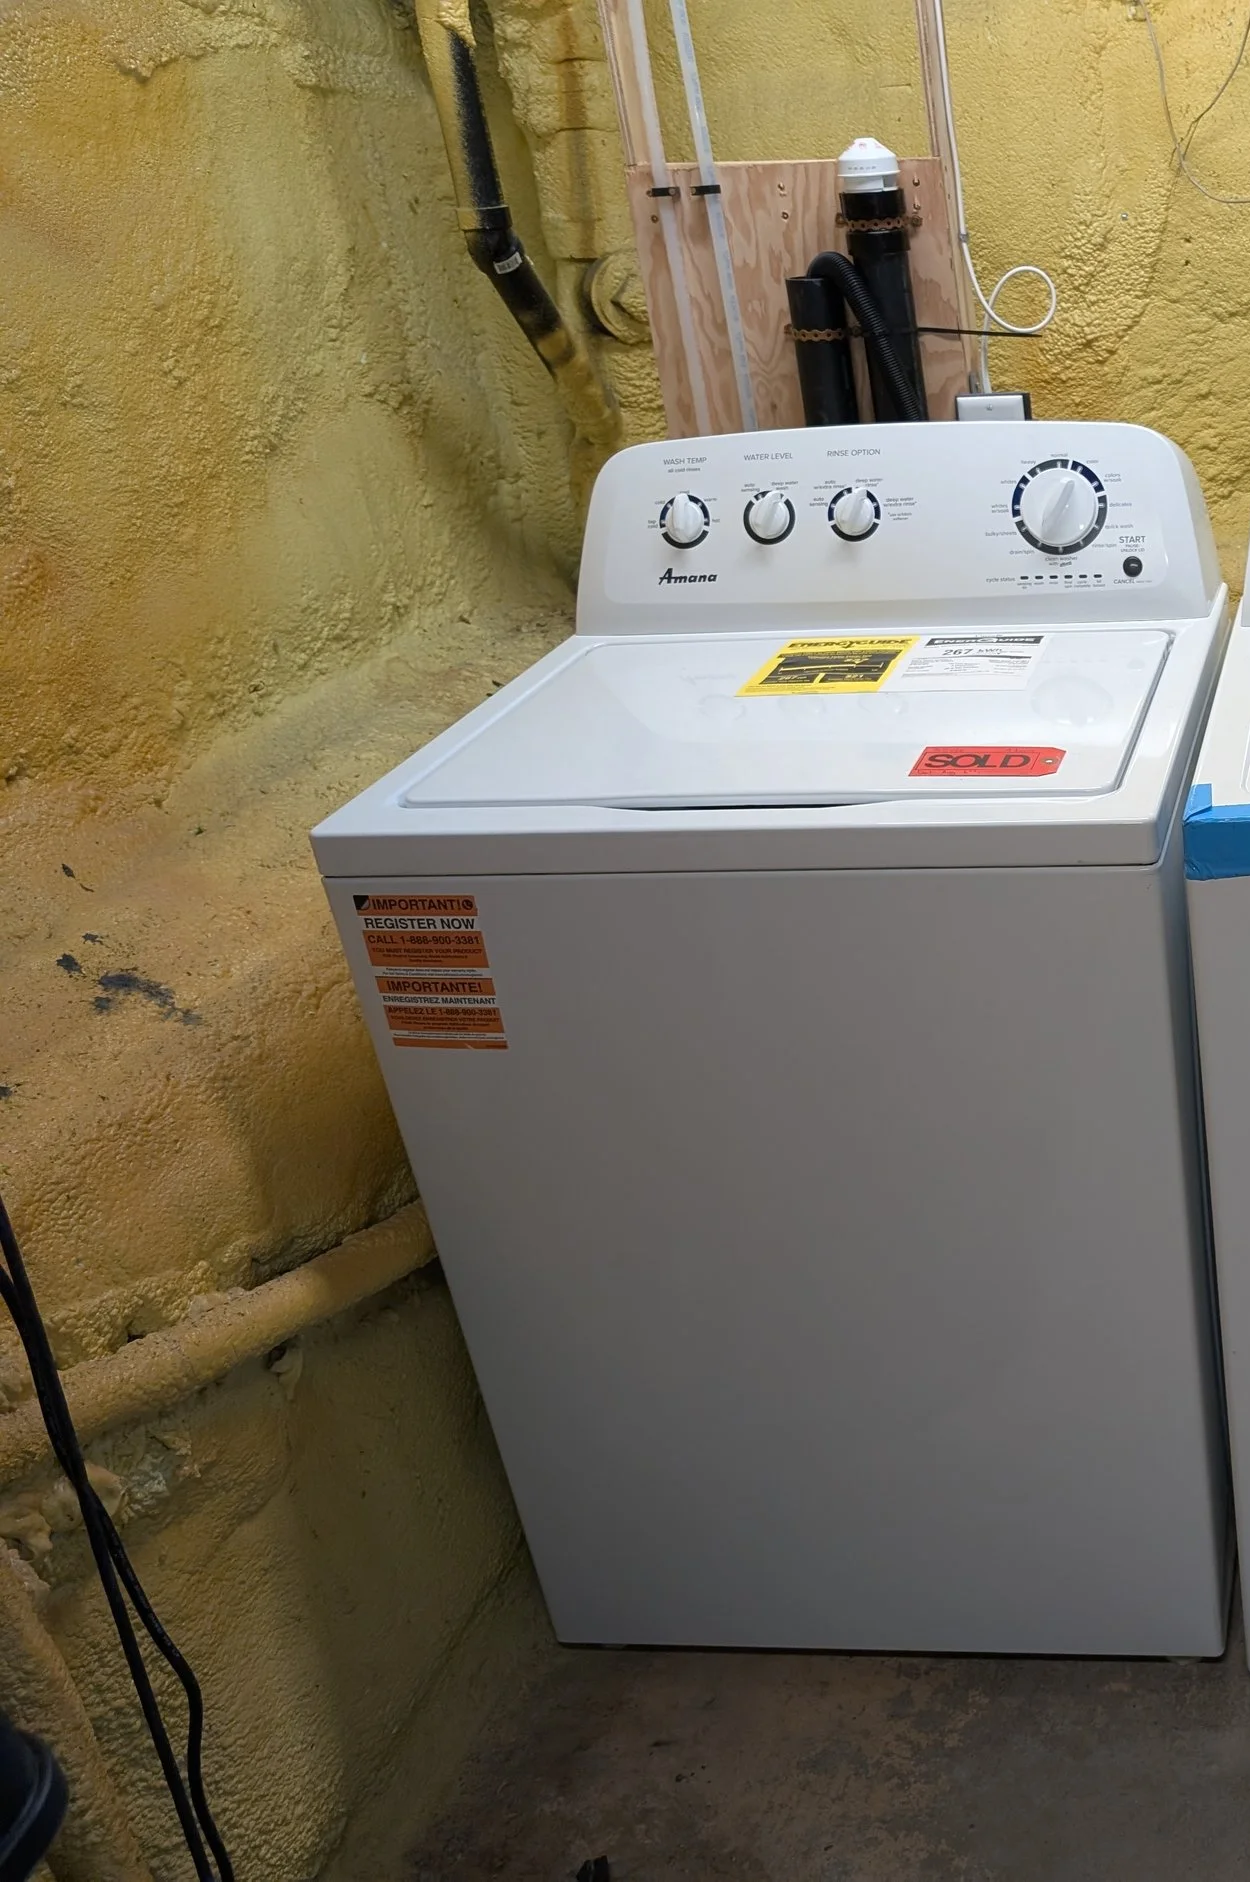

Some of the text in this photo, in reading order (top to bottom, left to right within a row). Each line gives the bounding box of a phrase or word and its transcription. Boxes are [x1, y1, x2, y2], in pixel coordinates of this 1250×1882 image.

[686, 456, 707, 464] TEMP
[770, 452, 793, 460] LEVEL
[1118, 535, 1146, 543] START
[657, 567, 718, 586] Amana
[942, 648, 975, 656] 267
[923, 753, 1032, 769] SOLD
[371, 899, 462, 911] IMPORTANT!
[364, 918, 475, 930] REGISTER NOW
[367, 935, 480, 945] CALL 1-888-900-3381
[386, 980, 484, 993] IMPORTANTE!
[382, 995, 497, 1006] ENREGISTREZ MAINTENANT
[387, 1007, 425, 1016] APPELEZ
[425, 1008, 438, 1016] LE
